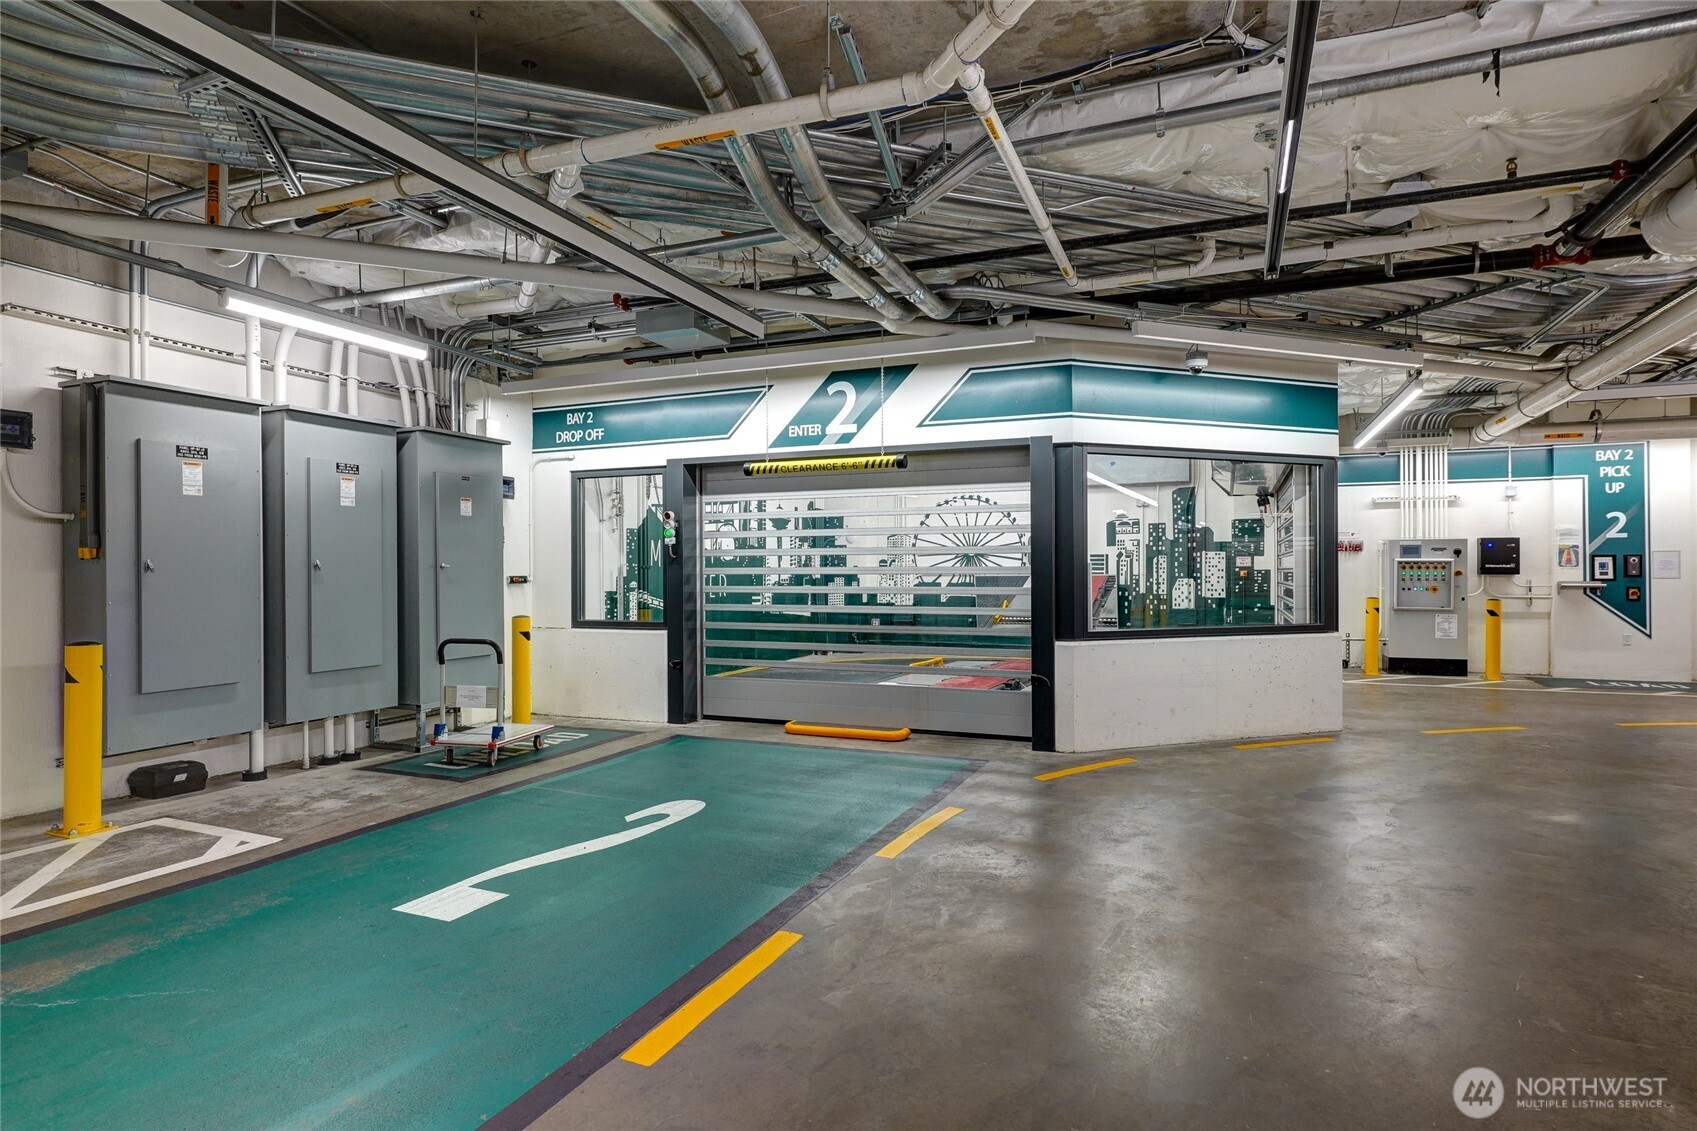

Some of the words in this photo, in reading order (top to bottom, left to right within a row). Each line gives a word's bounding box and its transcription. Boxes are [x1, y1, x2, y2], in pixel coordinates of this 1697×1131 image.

[208, 179, 219, 204] WASTE
[788, 423, 822, 438] ENTER
[825, 381, 858, 435] 2
[566, 412, 585, 425] BAY
[586, 411, 594, 424] 2
[555, 430, 584, 444] DROP
[585, 428, 605, 442] OFF
[1595, 449, 1622, 462] BAY
[1624, 449, 1634, 460] 2
[780, 463, 838, 474] CLEARANCE
[1600, 465, 1631, 478] PICK
[1605, 482, 1625, 494] UP
[1605, 511, 1628, 539] 2
[704, 574, 727, 598] ER
[391, 799, 706, 922] 2
